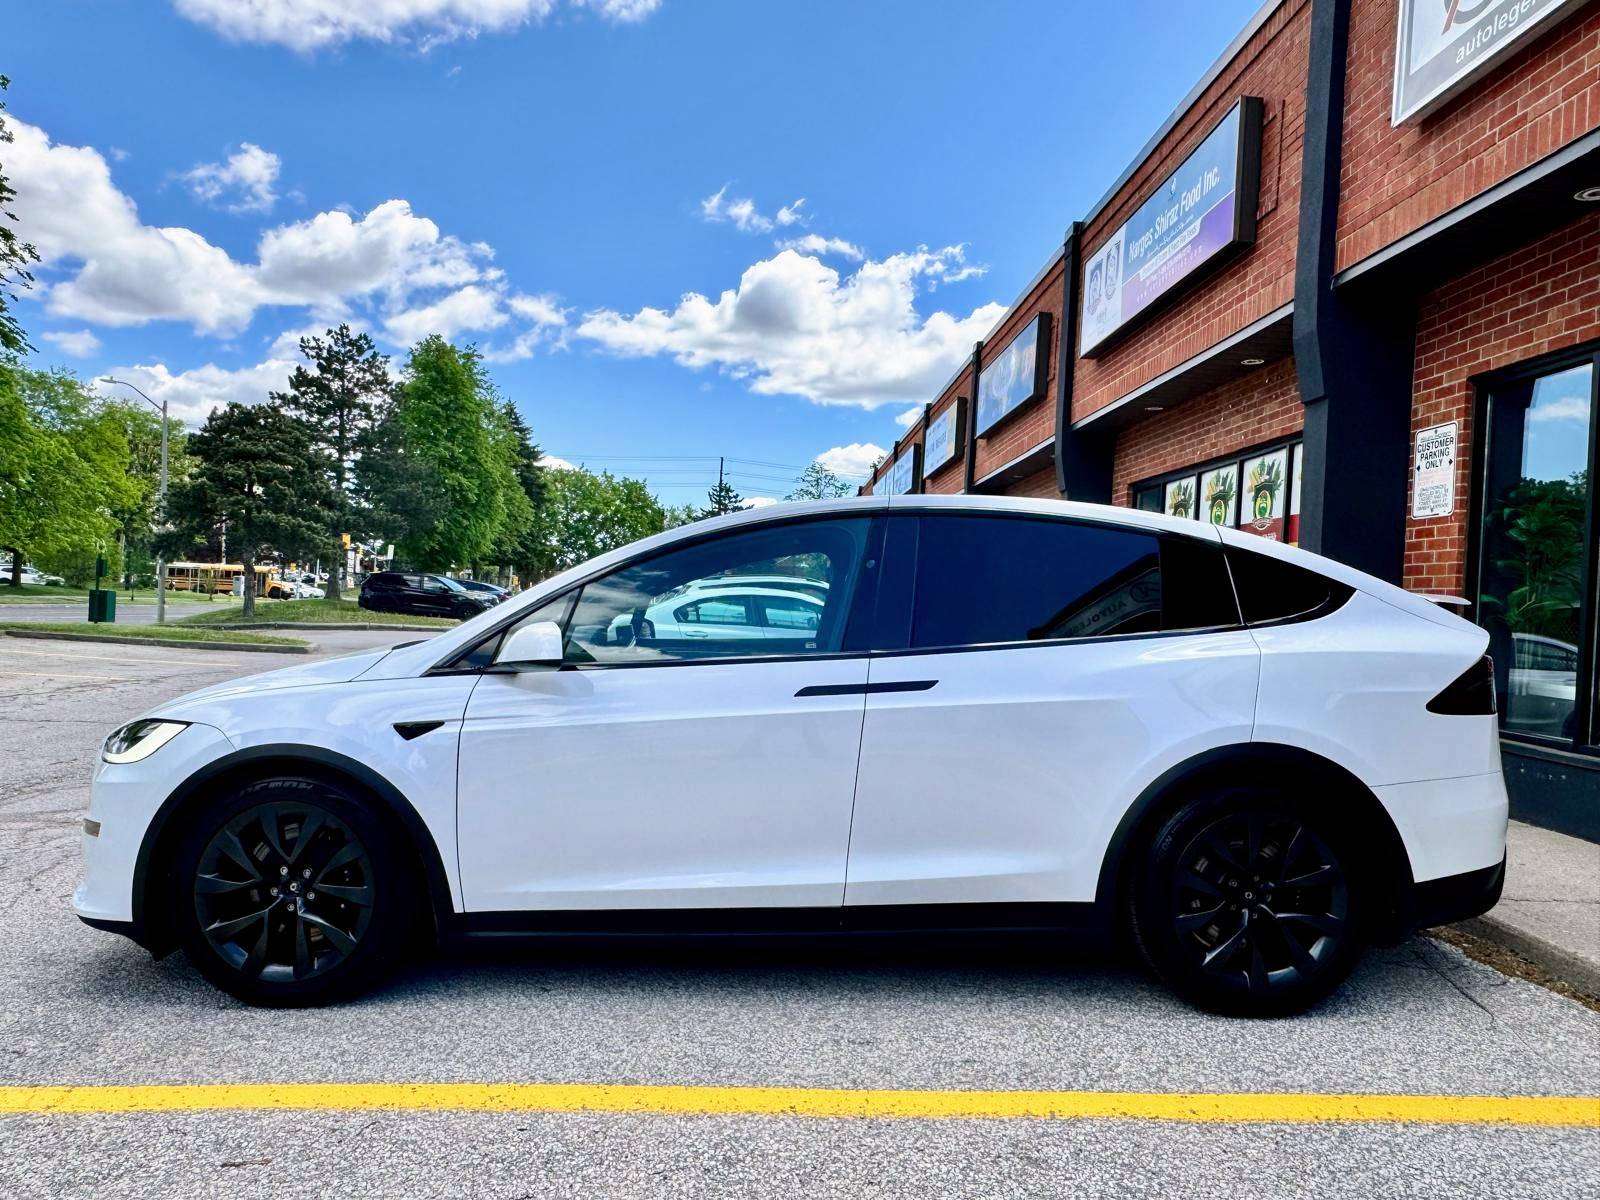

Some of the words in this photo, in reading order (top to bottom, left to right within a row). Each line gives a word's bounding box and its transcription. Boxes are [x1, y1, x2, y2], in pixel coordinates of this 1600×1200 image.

[1456, 0, 1535, 64] autolege
[1128, 229, 1154, 262] Narges
[1154, 206, 1179, 234] Shiraz
[1180, 178, 1203, 213] Food
[1203, 166, 1221, 195] Inc.
[1417, 437, 1454, 453] CUSTOMER
[1420, 447, 1450, 461] PARKING
[1425, 459, 1443, 470] ONLY
